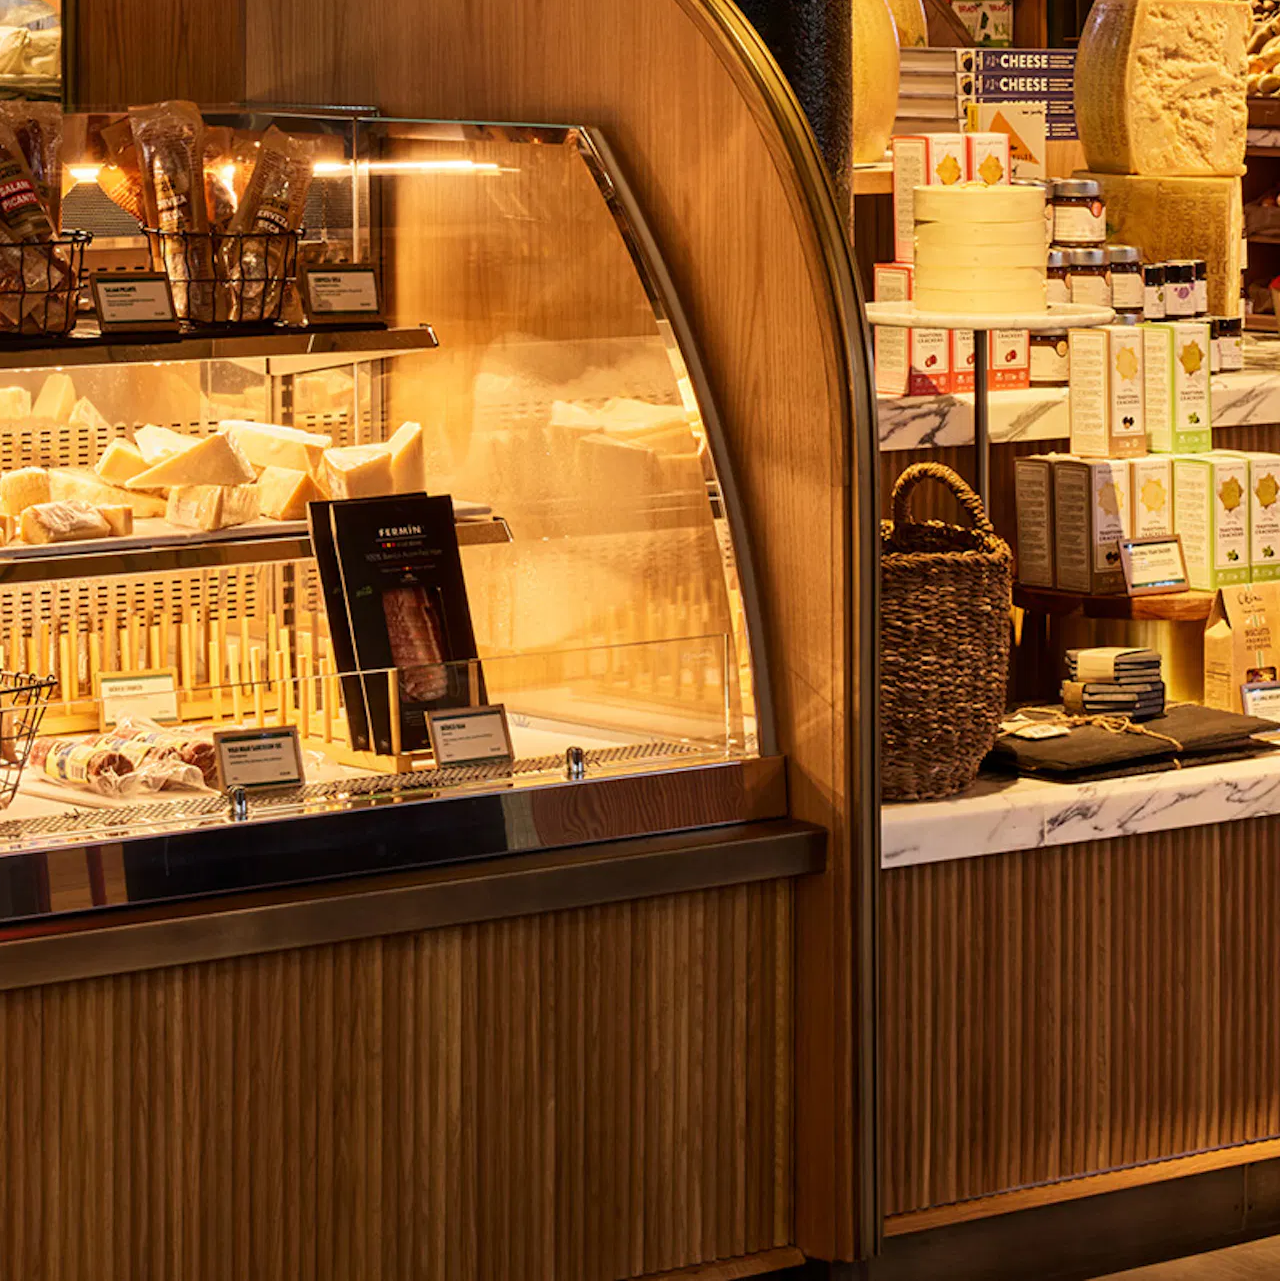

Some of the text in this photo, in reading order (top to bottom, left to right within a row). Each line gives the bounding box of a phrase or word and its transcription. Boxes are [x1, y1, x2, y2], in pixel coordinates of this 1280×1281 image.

[1000, 54, 1048, 69] CHEESE
[999, 77, 1048, 92] CHEESE
[378, 523, 422, 537] FERMÍN
[1245, 628, 1270, 637] BISCUITS
